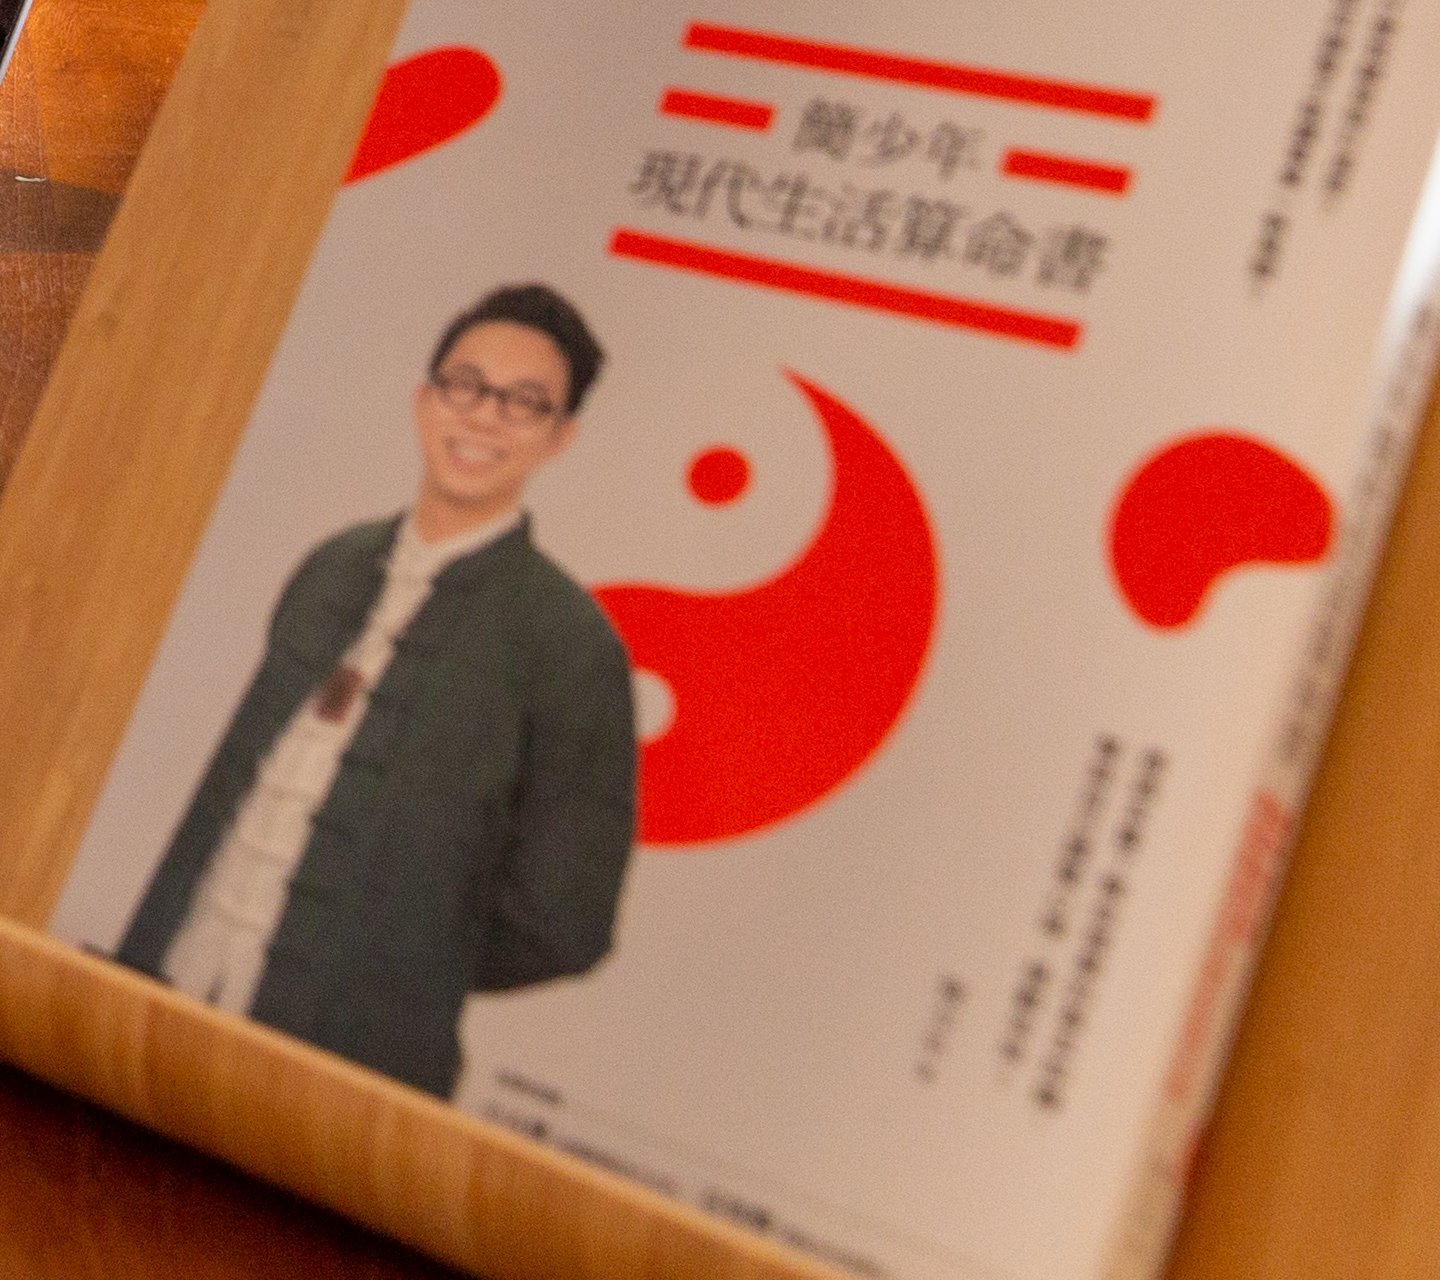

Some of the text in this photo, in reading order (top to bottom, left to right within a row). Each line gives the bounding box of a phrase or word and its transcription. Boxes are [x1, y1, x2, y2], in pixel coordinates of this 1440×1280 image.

[792, 94, 990, 184] 簡少年
[624, 145, 1114, 298] 現代生活算命書
